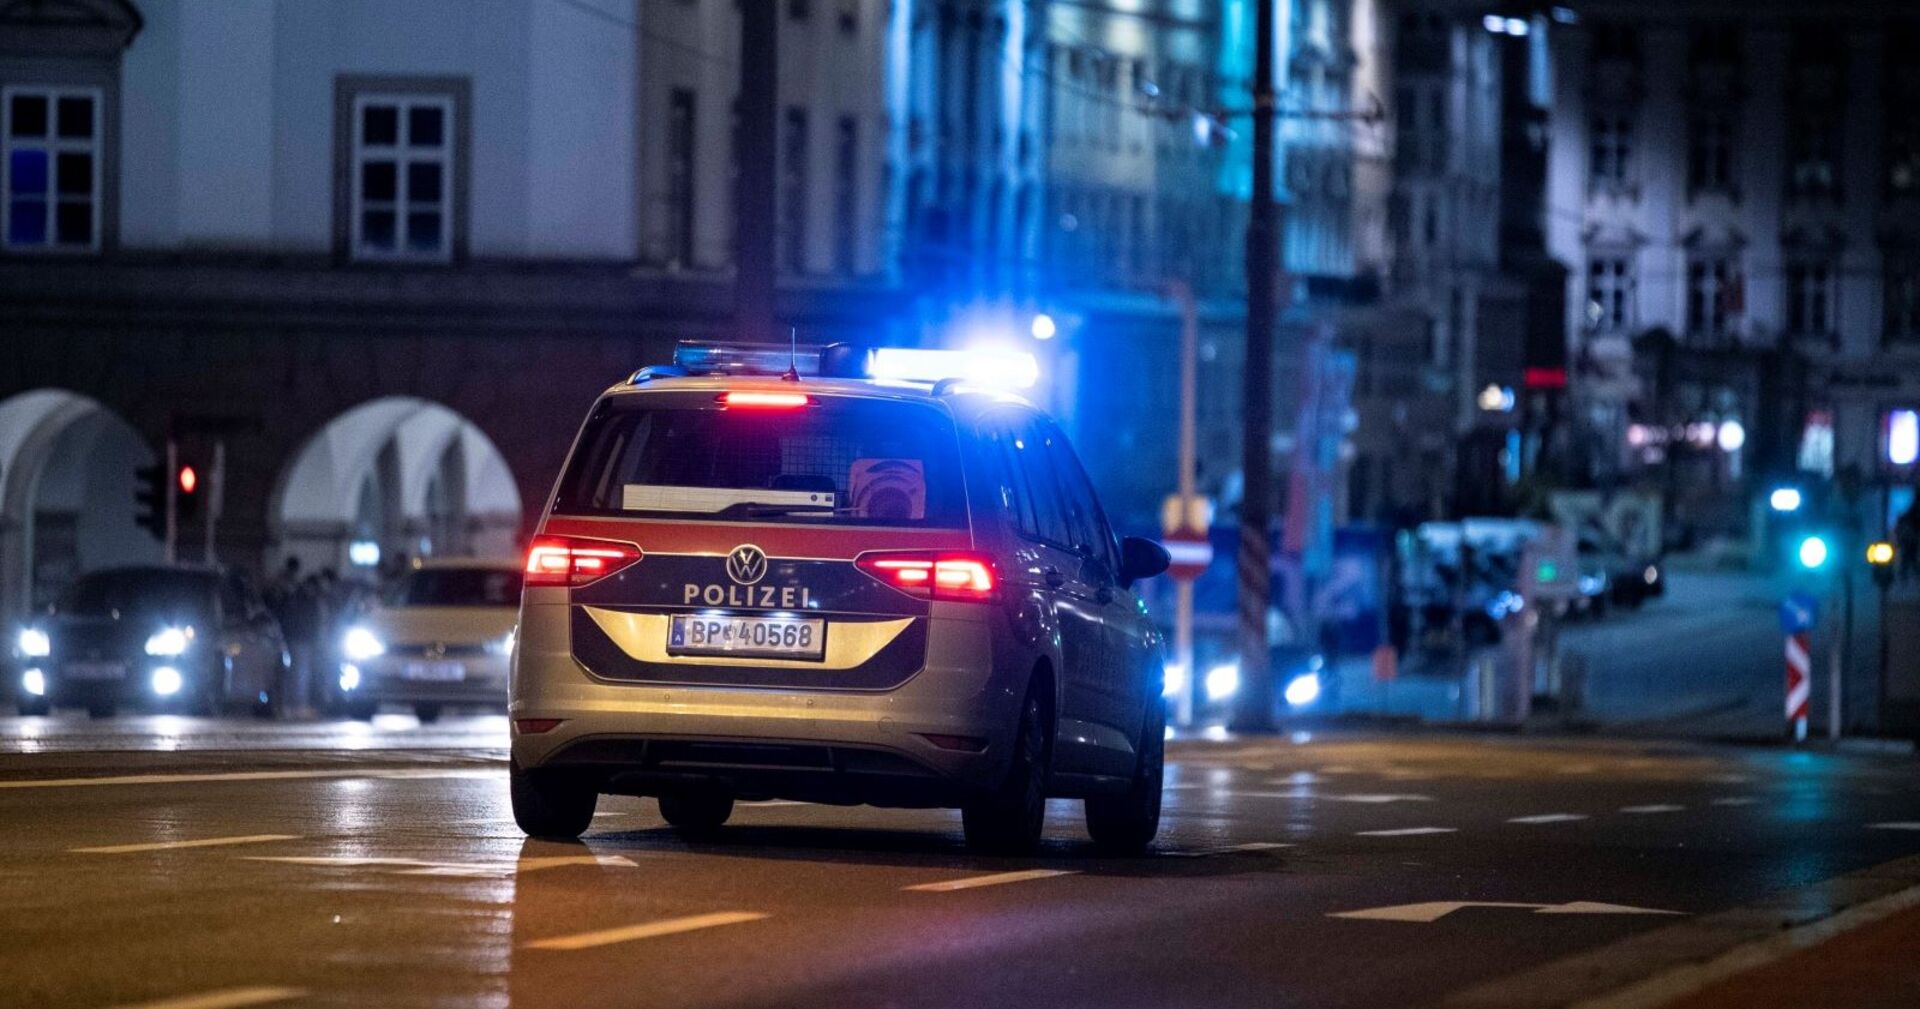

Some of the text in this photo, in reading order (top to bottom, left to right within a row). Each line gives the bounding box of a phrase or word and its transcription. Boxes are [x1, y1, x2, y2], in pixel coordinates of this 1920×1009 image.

[729, 546, 765, 582] VW
[684, 584, 809, 608] POLIZEI
[692, 621, 721, 644] BP
[739, 622, 811, 647] 40568
